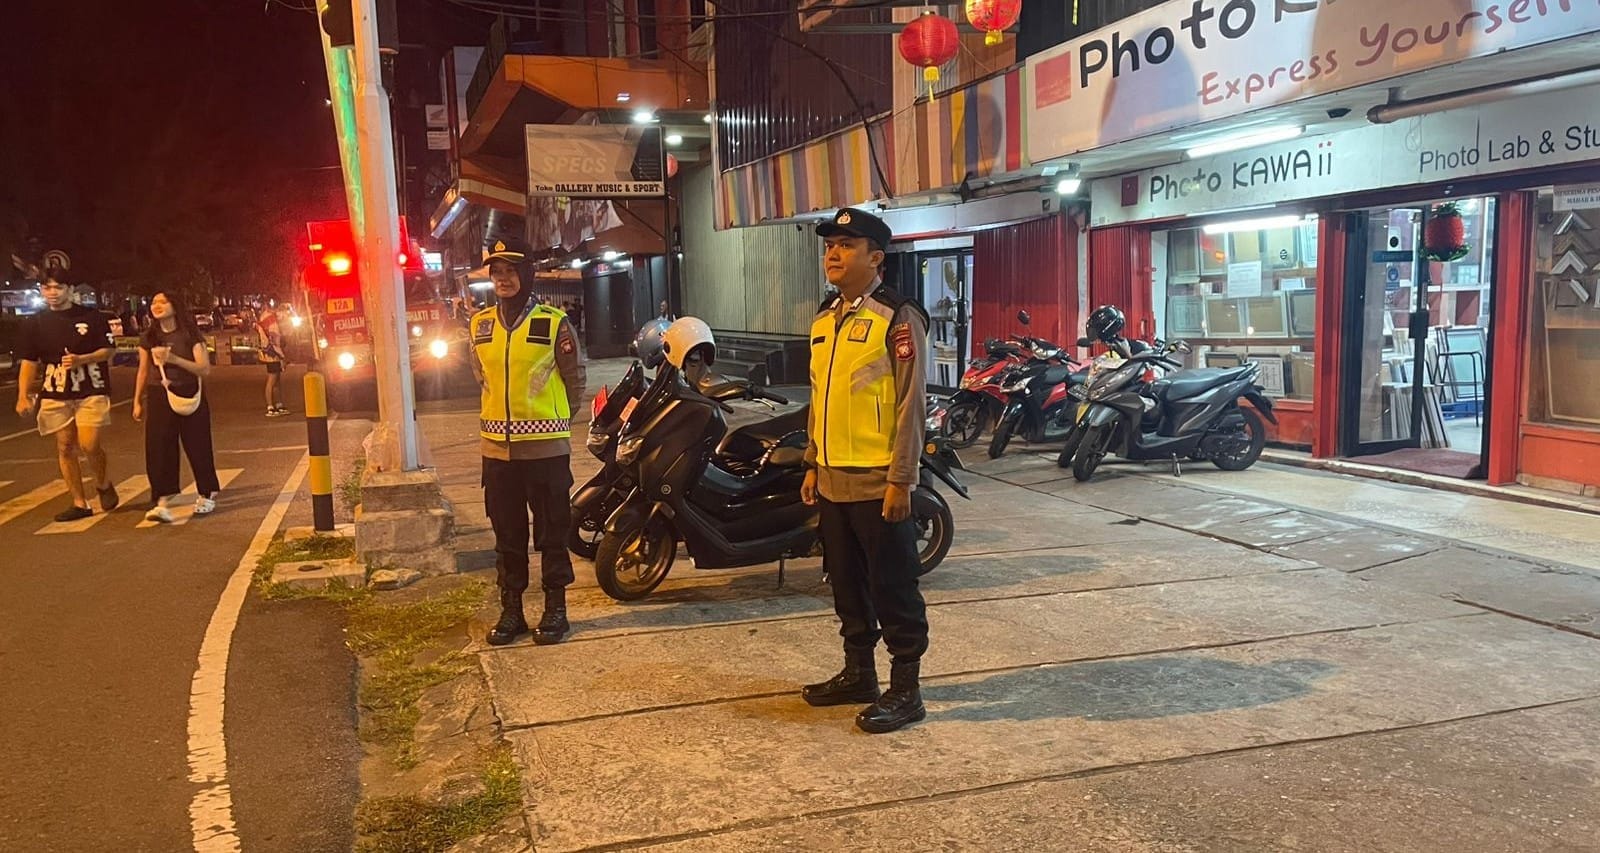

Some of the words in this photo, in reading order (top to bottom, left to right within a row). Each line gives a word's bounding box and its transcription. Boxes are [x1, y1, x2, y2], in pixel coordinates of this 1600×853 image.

[1080, 0, 1256, 88] Photo
[1197, 50, 1338, 105] Express
[542, 156, 607, 175] SPECS
[1150, 167, 1222, 202] Photo
[1232, 141, 1333, 190] KAWAii
[1420, 146, 1480, 173] Photo
[1488, 135, 1531, 163] Lab
[1538, 130, 1555, 154] &
[555, 183, 593, 193] GALLERY
[595, 183, 623, 193] MUSIC
[625, 183, 631, 193] &
[633, 183, 660, 193] SPORT
